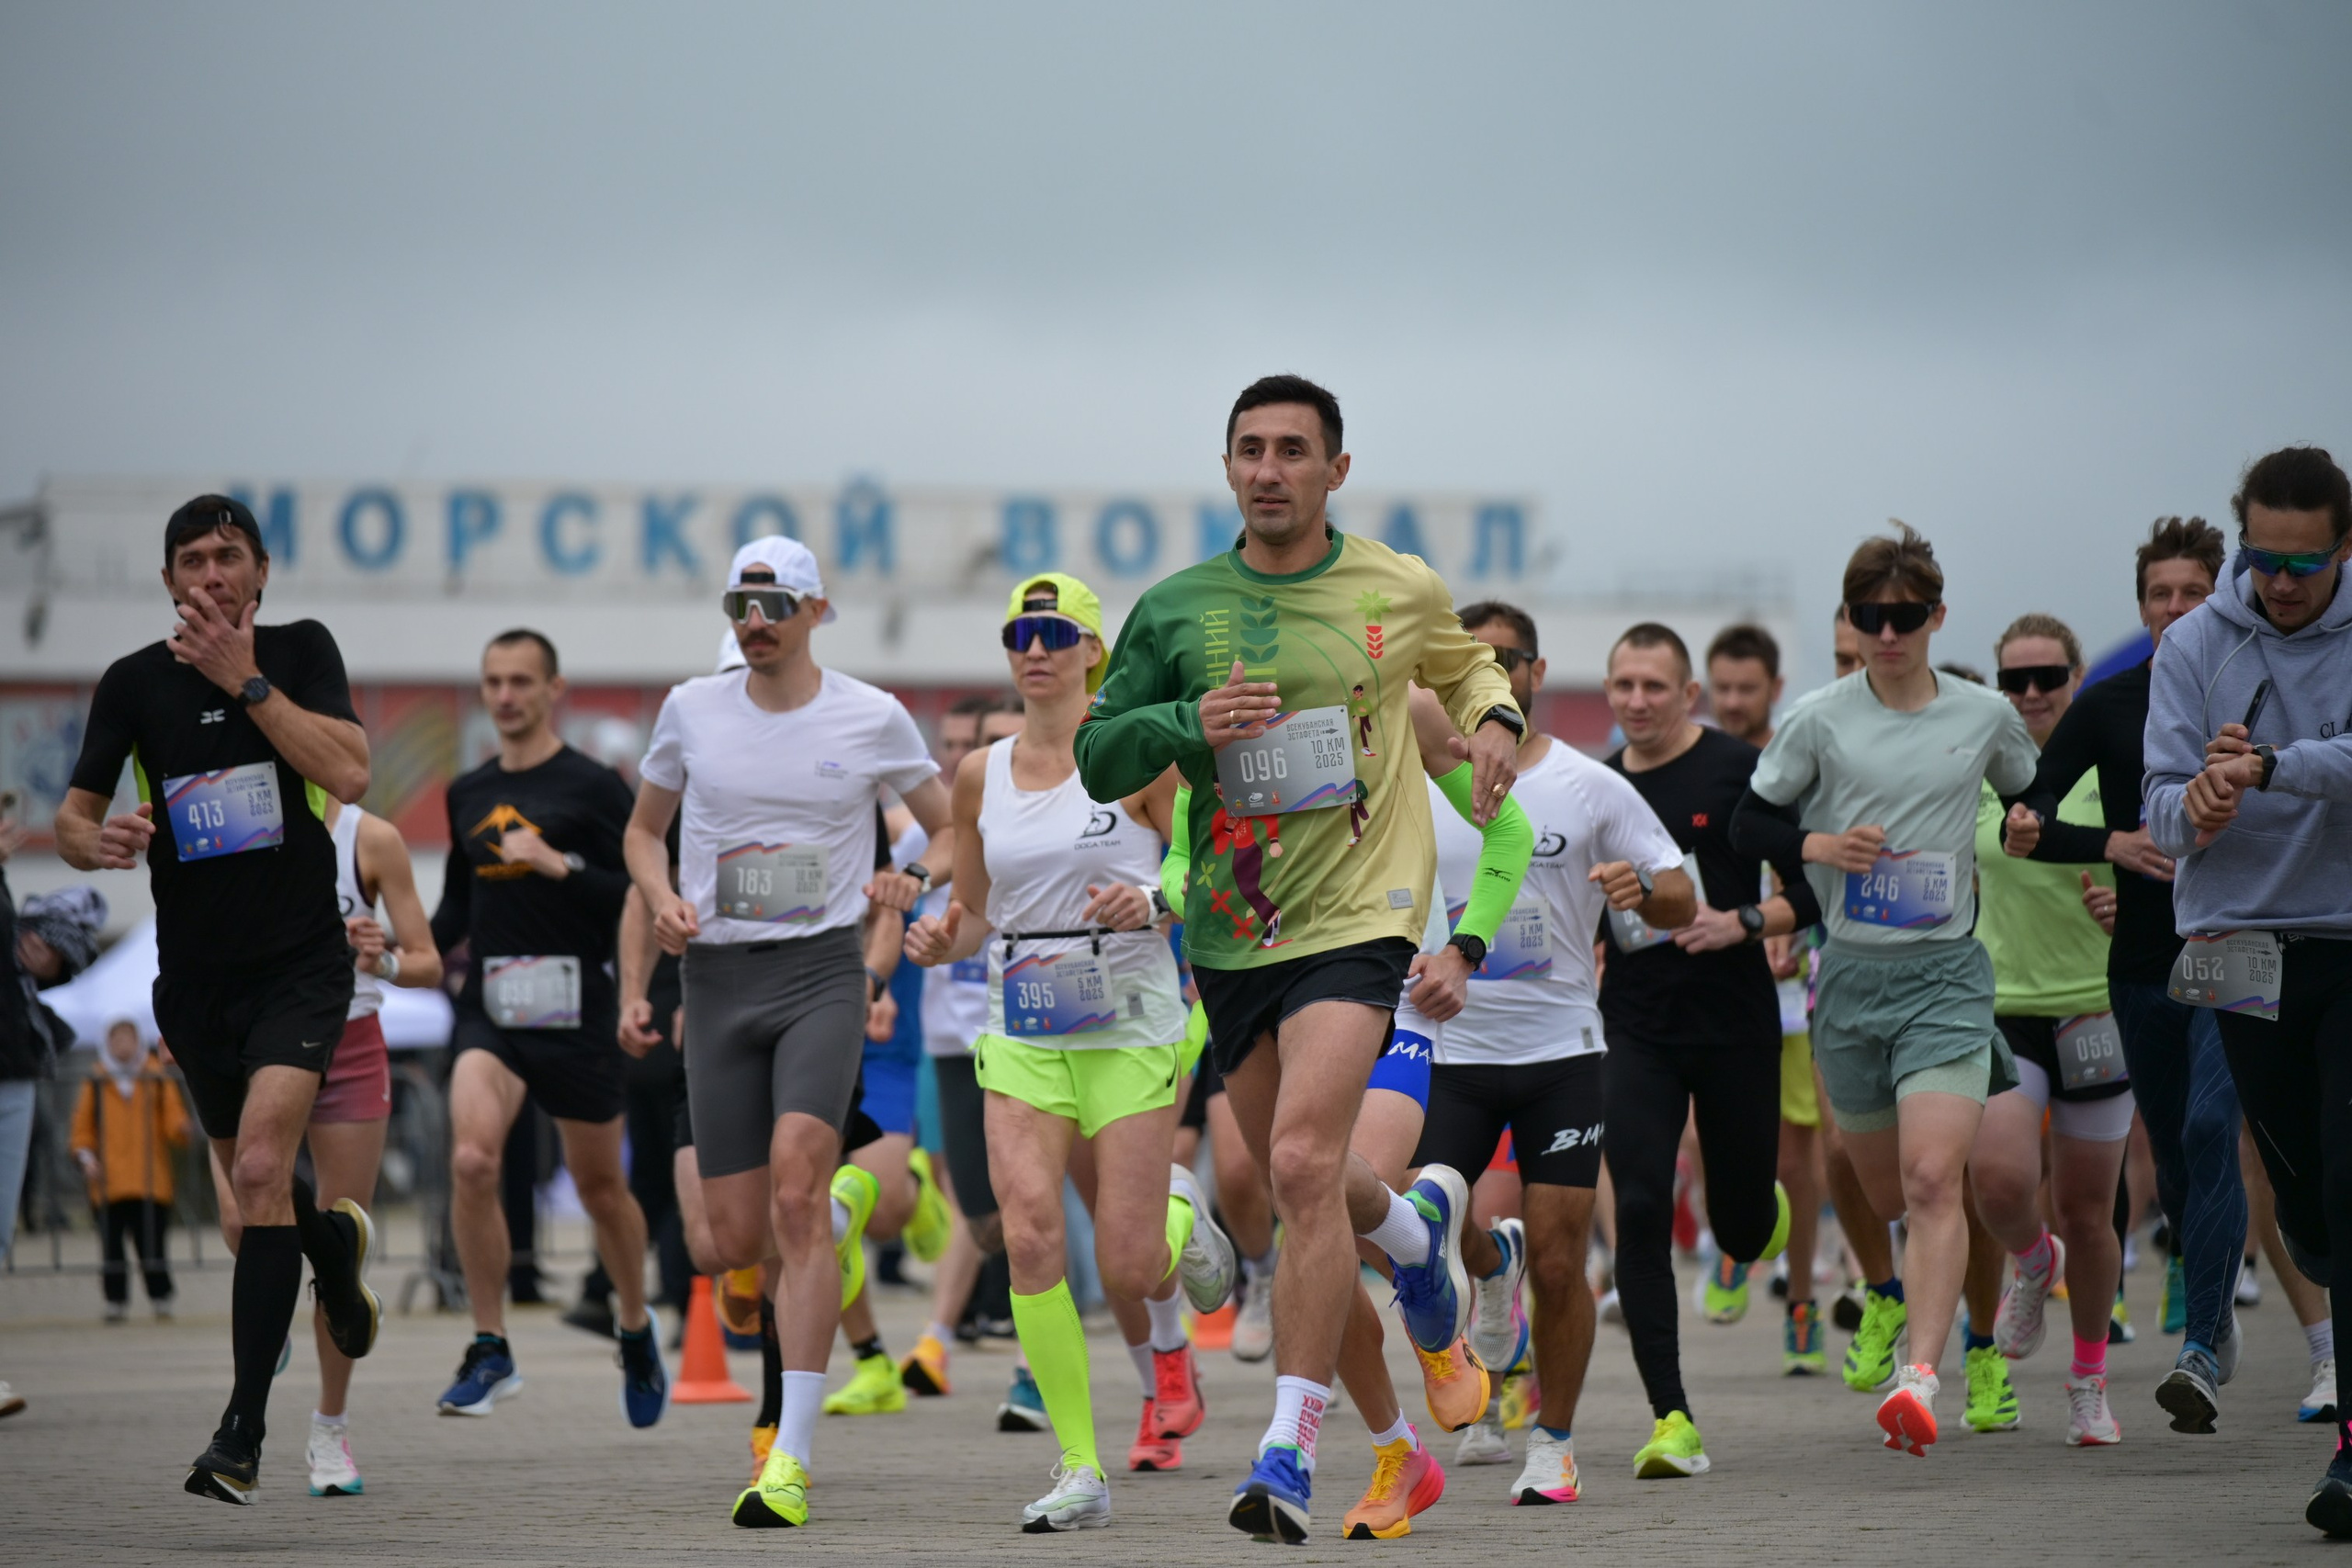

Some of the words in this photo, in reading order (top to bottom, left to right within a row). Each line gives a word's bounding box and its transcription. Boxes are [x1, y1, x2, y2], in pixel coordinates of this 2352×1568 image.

[230, 476, 898, 575] МОРСКОЙ
[1286, 718, 1334, 732] ВСЕКУБАНСКАЯ
[1287, 728, 1320, 740] ЭСТАФЕТА
[1311, 739, 1323, 754] 10
[1327, 737, 1345, 752] КМ
[1239, 747, 1287, 783] 096
[1315, 752, 1344, 769] 2025
[248, 792, 254, 804] 5
[188, 799, 225, 830] 413
[249, 802, 275, 817] 2025
[736, 867, 773, 896] 183
[1861, 872, 1899, 902] 246
[1922, 889, 1947, 902] 2025
[1520, 924, 1526, 935] 5
[1529, 923, 1544, 934] КМ
[1520, 934, 1544, 949] 2025
[2183, 954, 2224, 981] 052
[2247, 956, 2257, 969] 10
[2261, 958, 2277, 972] КМ
[1078, 977, 1084, 989] 5
[1087, 975, 1102, 987] КМ
[2249, 969, 2274, 985] 2025
[1017, 982, 1056, 1009] 395
[1080, 987, 1104, 1001] 2025
[2076, 1032, 2113, 1062] 055
